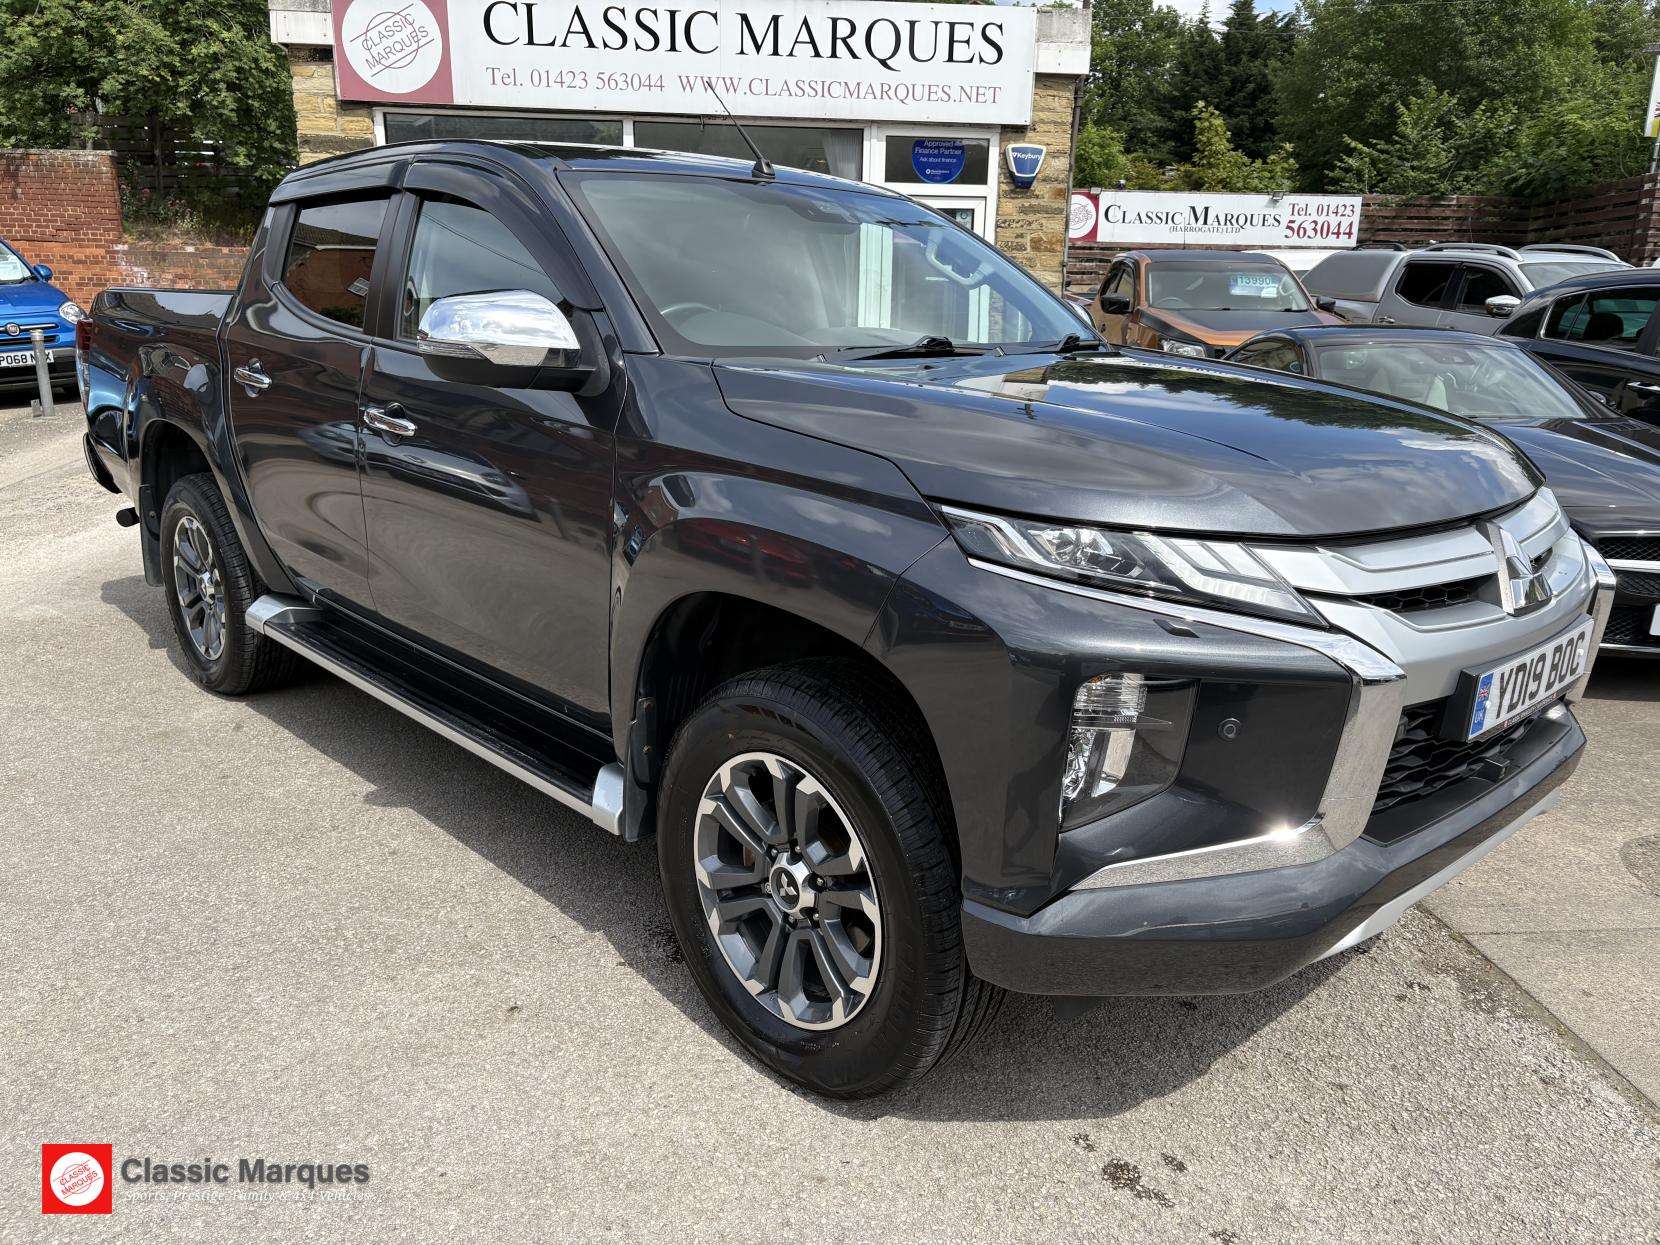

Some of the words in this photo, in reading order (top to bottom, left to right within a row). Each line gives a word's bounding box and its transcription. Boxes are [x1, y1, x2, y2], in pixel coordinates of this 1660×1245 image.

[361, 12, 416, 52] CLASSIC
[365, 25, 429, 71] MARQUES
[483, 0, 719, 54] CLASSIC
[735, 12, 1005, 72] MARQUES
[485, 66, 524, 88] Tel.
[530, 68, 589, 90] 01423
[596, 71, 665, 93] 563044
[678, 75, 1002, 105] WWW.CLASSICMARQUES.NET
[923, 139, 954, 148] Approved
[940, 147, 963, 155] Partner
[1104, 204, 1184, 226] CLASSIC
[1186, 205, 1282, 230] MARQUES
[1288, 202, 1311, 217] Tel.
[1317, 203, 1356, 218] 01423
[1284, 219, 1354, 240] 563044
[1496, 653, 1547, 719] YD19
